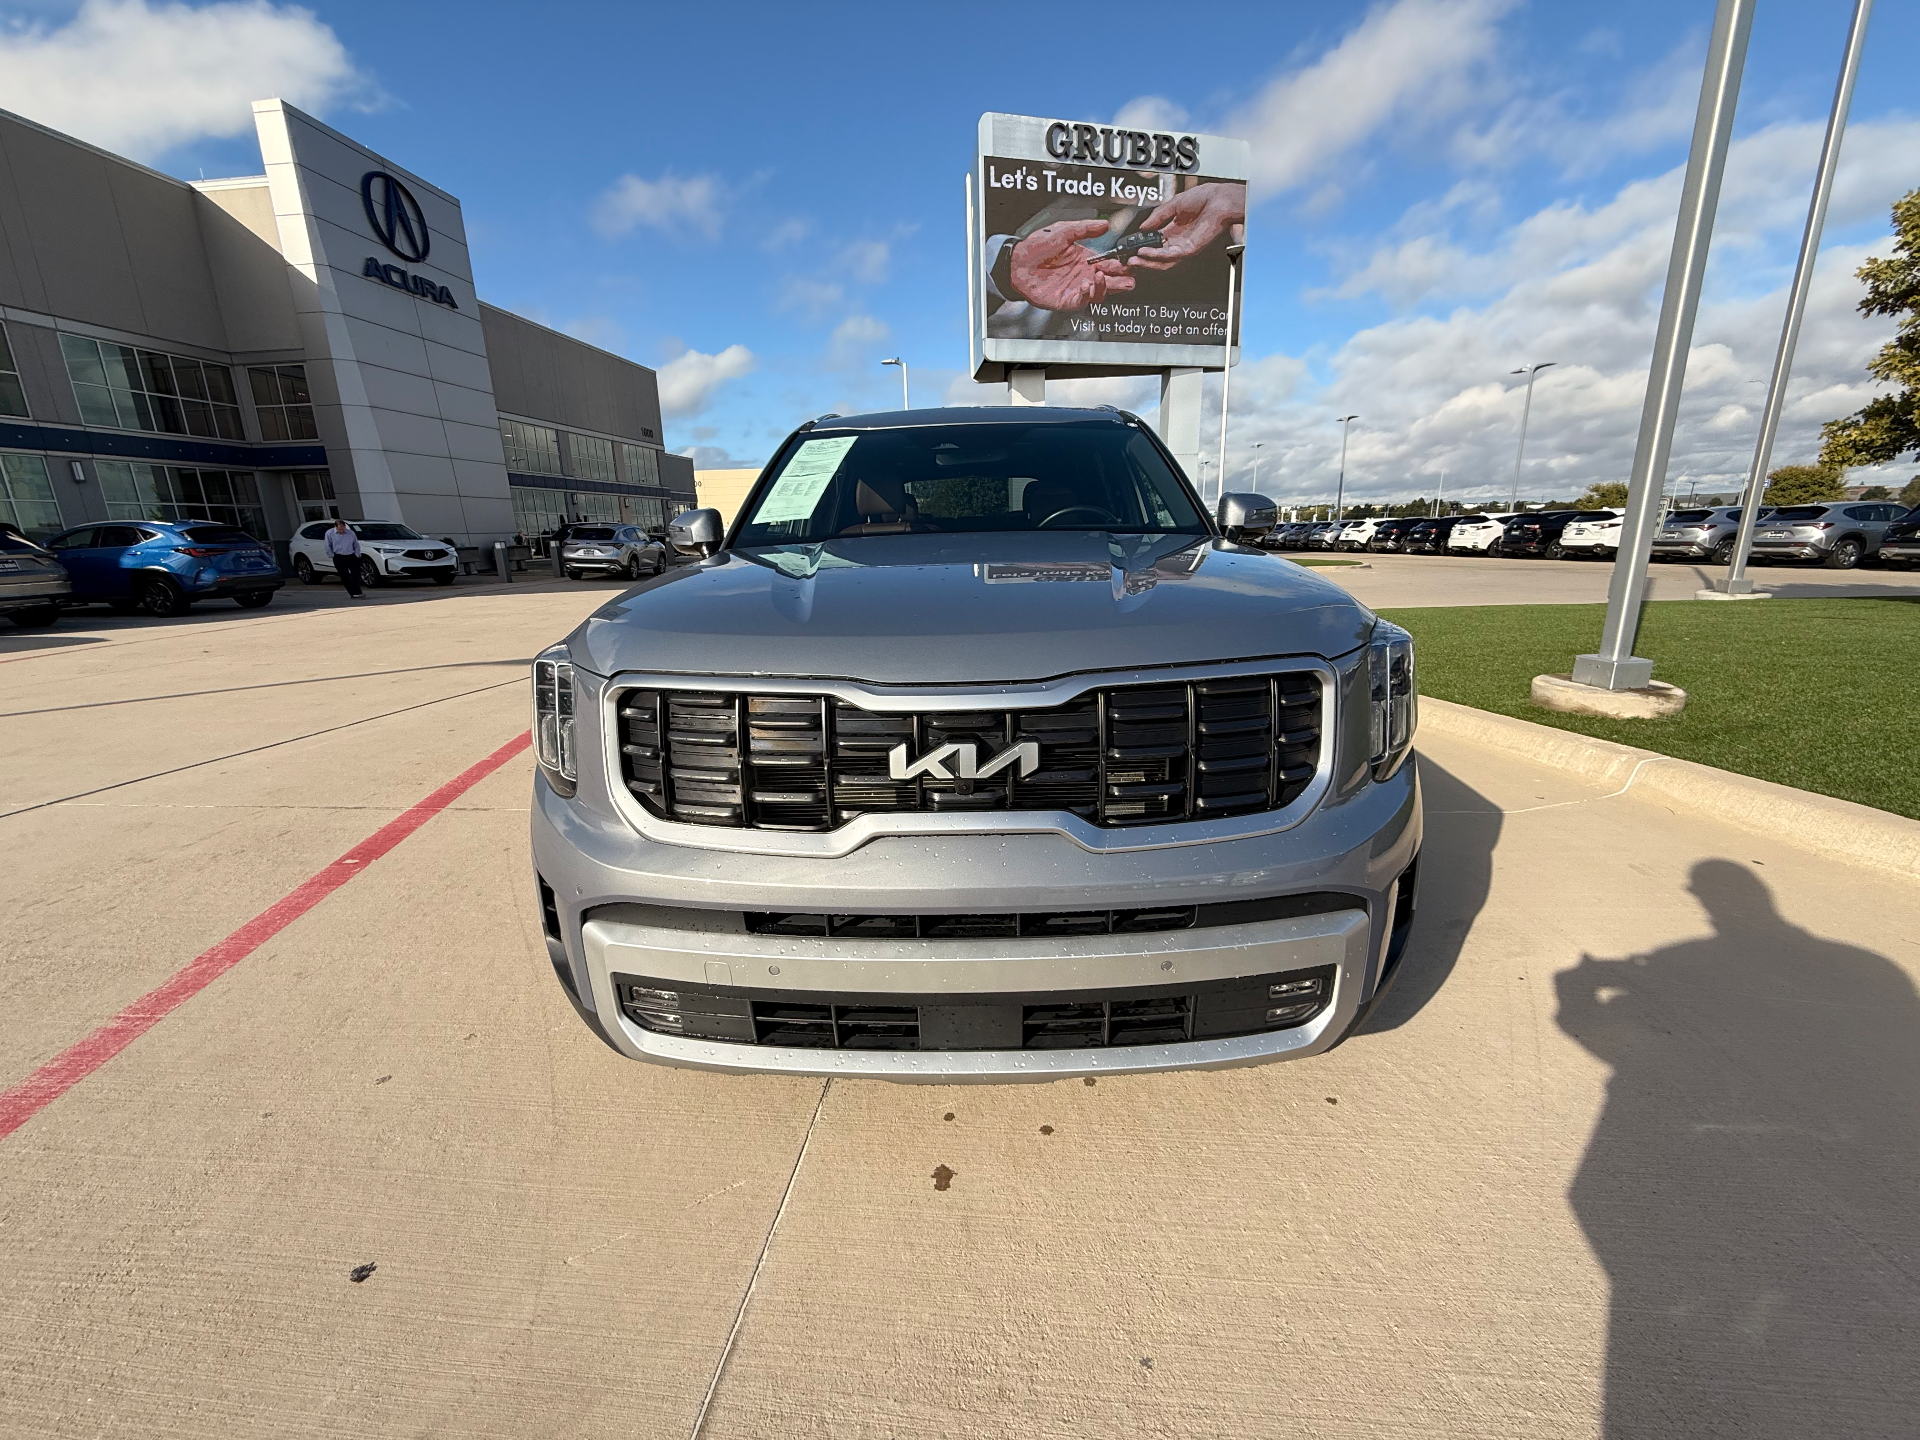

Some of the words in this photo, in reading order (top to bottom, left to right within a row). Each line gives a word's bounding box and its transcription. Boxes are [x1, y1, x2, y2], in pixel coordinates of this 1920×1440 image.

[1046, 122, 1198, 169] GRUBBS
[989, 165, 1038, 191] Let's
[1042, 170, 1105, 197] Trade
[1110, 176, 1164, 206] Keys!
[363, 256, 459, 309] ACURA
[1070, 318, 1095, 332] Visit
[1099, 323, 1111, 333] us
[1114, 320, 1147, 337] today
[1149, 323, 1161, 334] to
[1164, 323, 1182, 338] get
[1186, 327, 1200, 335] an
[1090, 303, 1108, 316] We
[1111, 304, 1141, 317] Want
[1143, 305, 1157, 318] To
[1160, 306, 1180, 321] Buy
[1182, 307, 1207, 320] Your
[888, 740, 1039, 780] KIA
